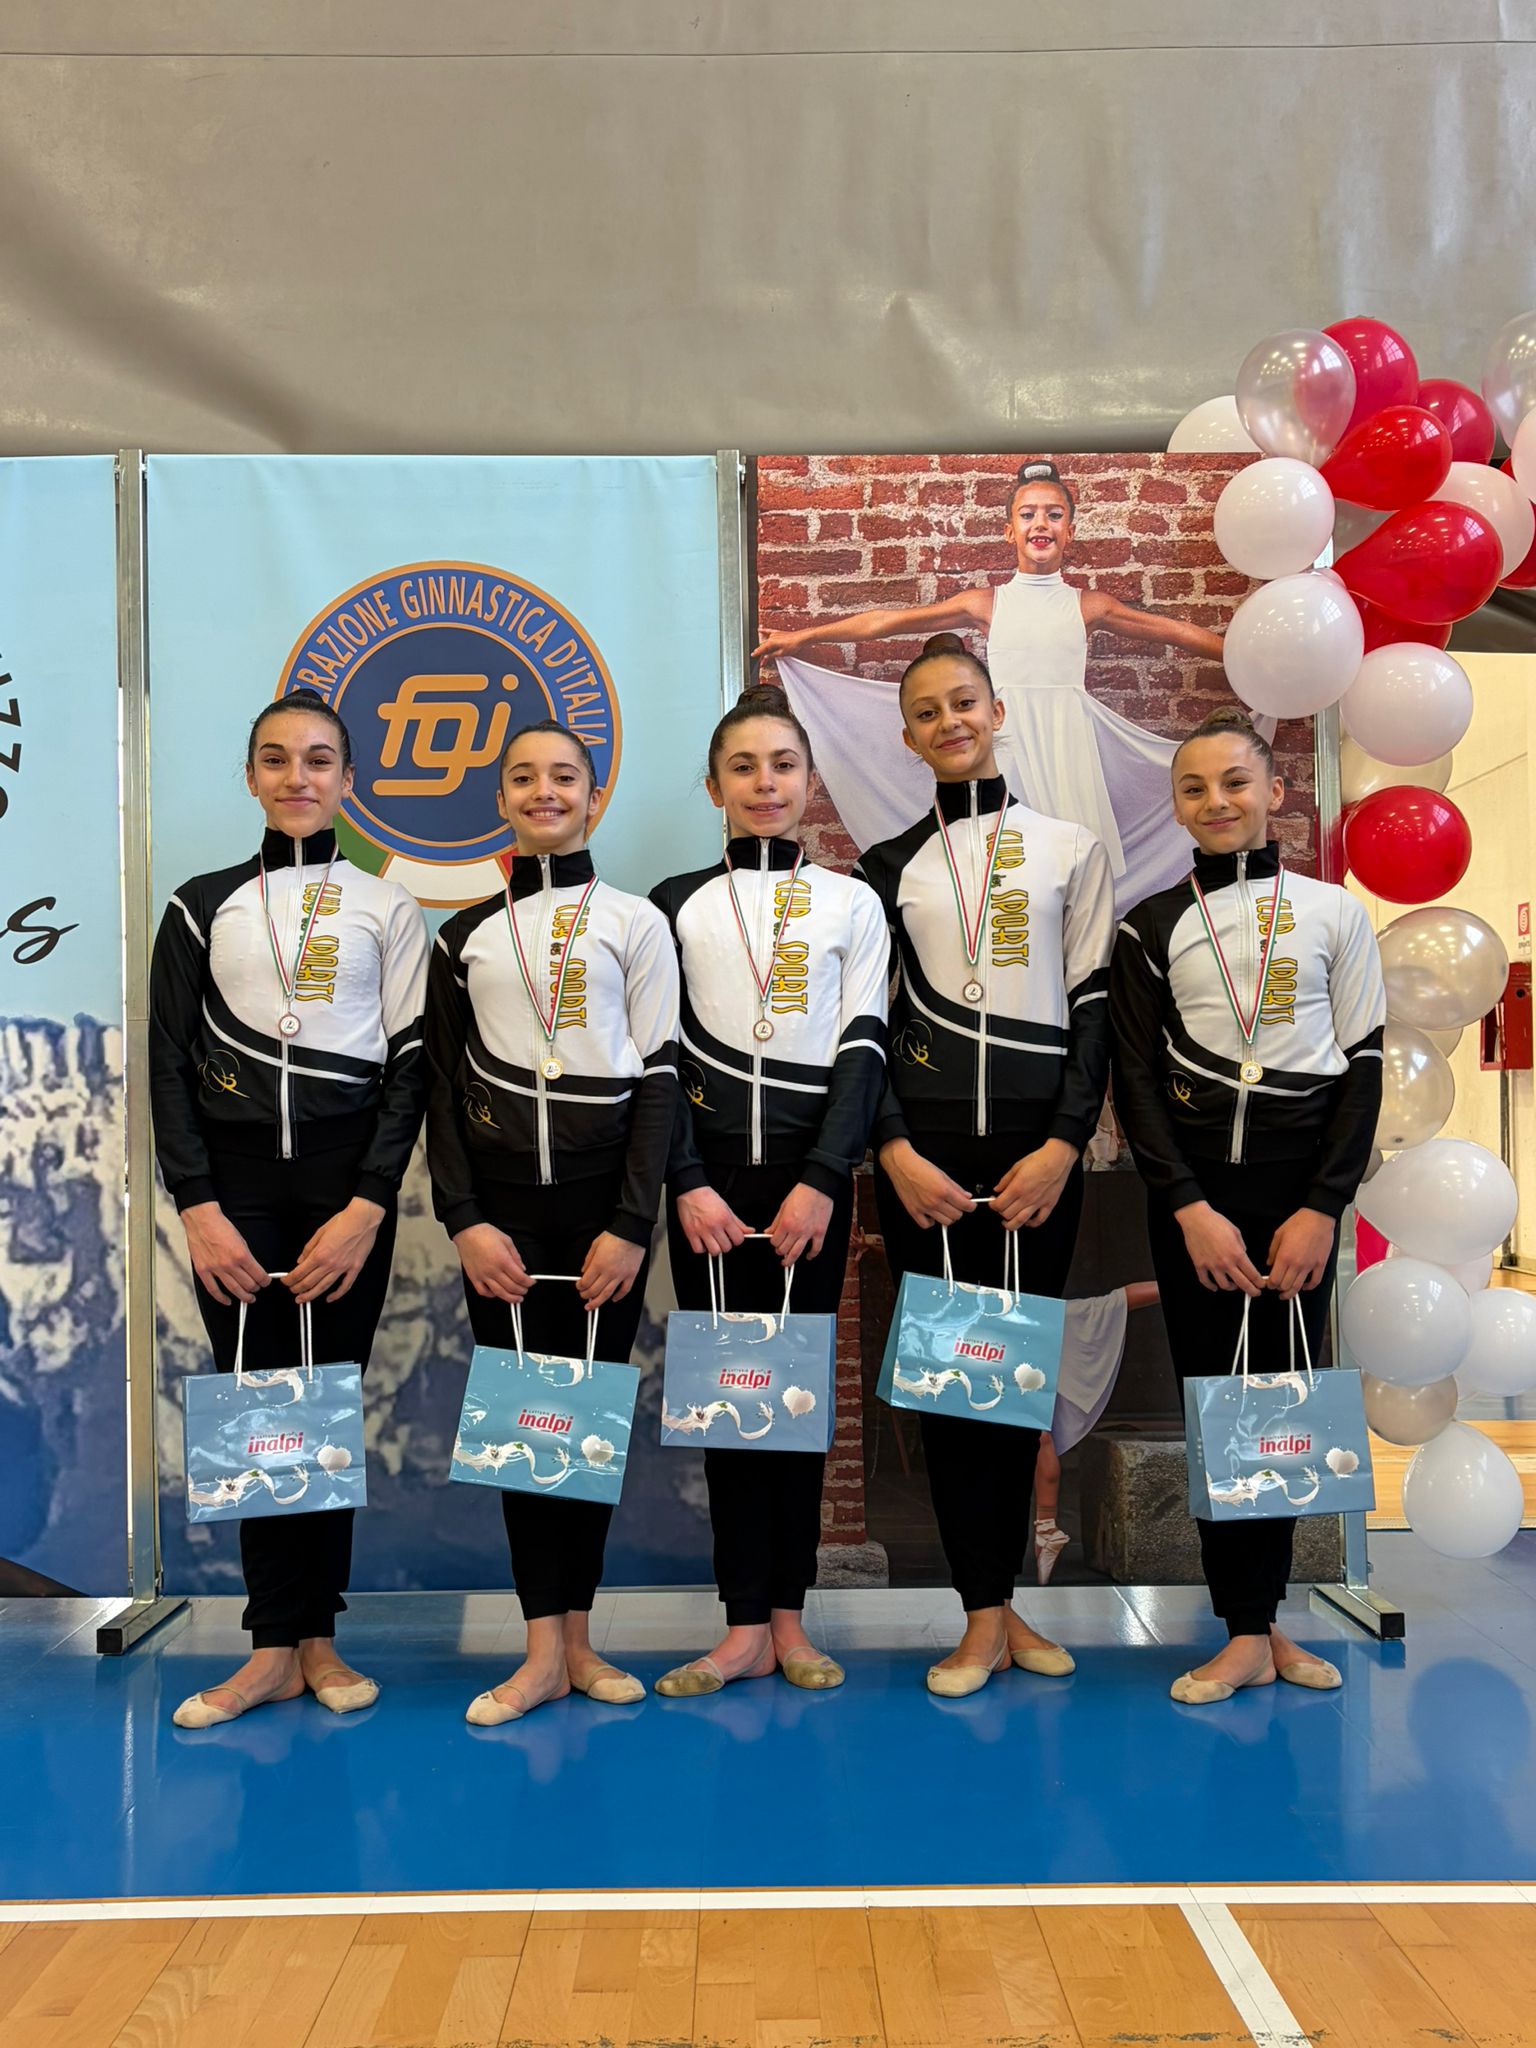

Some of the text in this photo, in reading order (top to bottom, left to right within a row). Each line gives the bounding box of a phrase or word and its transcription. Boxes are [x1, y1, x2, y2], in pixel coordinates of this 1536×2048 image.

[291, 576, 607, 747] RAZIONE GINNASTICA D'ITALIA
[986, 829, 1025, 870] CLUB
[302, 882, 343, 916] CLUB
[774, 878, 811, 918] CLUB
[1255, 896, 1296, 935] CLUB
[551, 904, 590, 938] CLUB
[991, 889, 1029, 967] SPORTS
[295, 935, 340, 1004] SPORTS
[771, 941, 810, 1015] SPORTS
[549, 958, 587, 1029] SPORTS
[1259, 957, 1298, 1025] SPORTS
[954, 1337, 1006, 1361] inalpi
[719, 1368, 771, 1389] inalpi
[518, 1408, 573, 1433] inalpi
[248, 1431, 304, 1453] inalpi
[1259, 1433, 1311, 1454] inalpi
